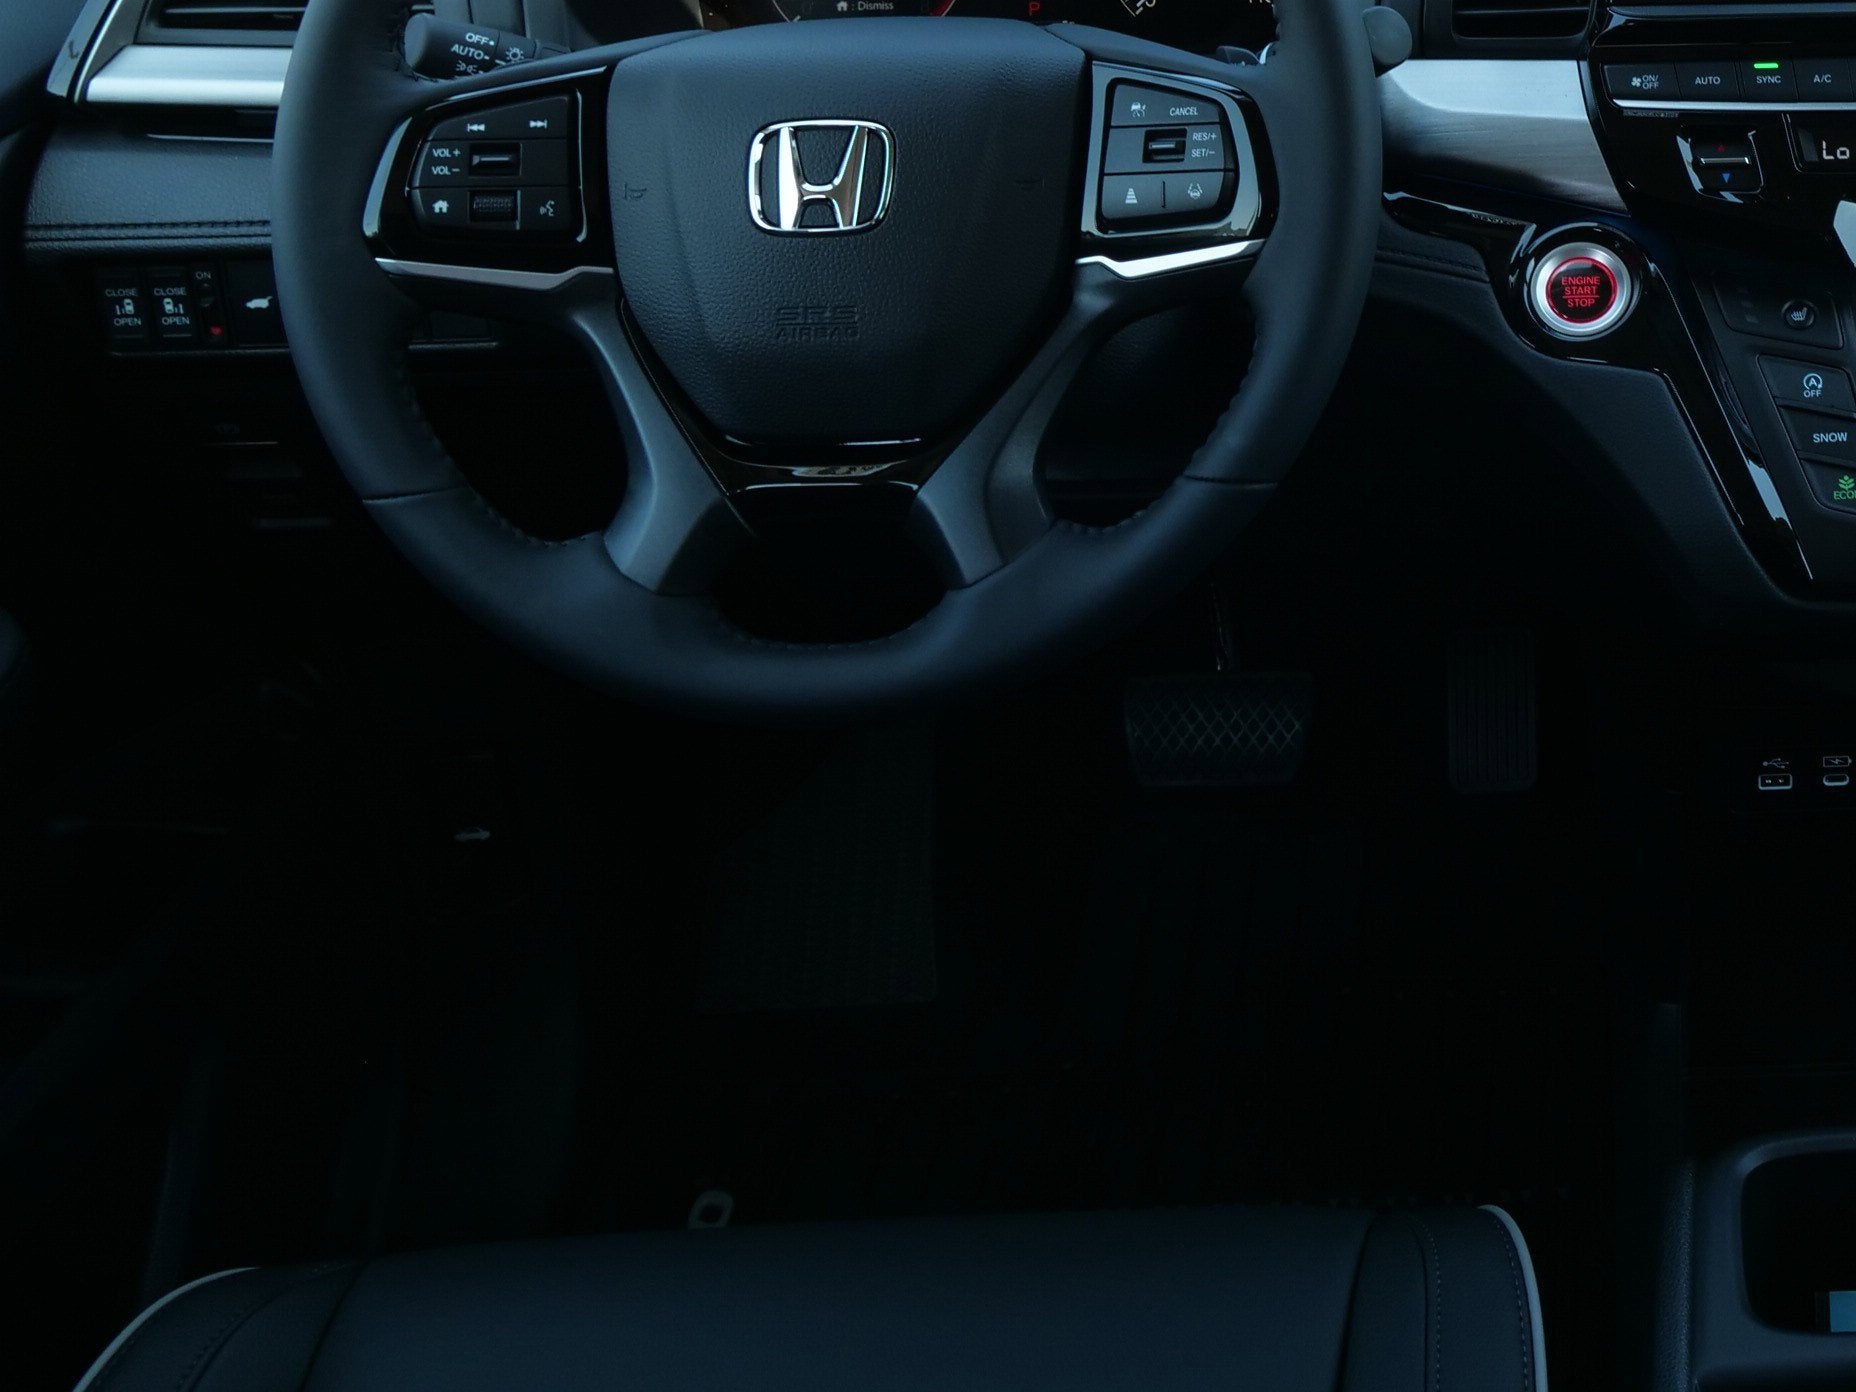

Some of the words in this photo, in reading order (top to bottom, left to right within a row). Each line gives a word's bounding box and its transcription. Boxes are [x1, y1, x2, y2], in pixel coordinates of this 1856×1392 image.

[857, 0, 895, 11] Dismiss
[1028, 0, 1041, 16] P
[465, 32, 490, 46] OFF
[451, 43, 484, 61] AUTO
[1641, 75, 1659, 83] ON/
[1694, 76, 1721, 86] AUTO
[1756, 75, 1782, 85] SYNC
[1813, 74, 1832, 84] A/C
[1641, 81, 1659, 90] OFF
[1169, 106, 1199, 116] CANCEL
[195, 271, 212, 279] ON
[1561, 275, 1601, 287] ENGINE
[104, 288, 139, 298] CLOSE
[153, 287, 187, 297] CLOSE
[1564, 286, 1598, 296] START
[1567, 297, 1596, 308] STOP
[113, 317, 142, 327] OPEN
[161, 316, 190, 326] OPEN
[1803, 389, 1822, 398] OFF
[1812, 431, 1848, 444] SNOW
